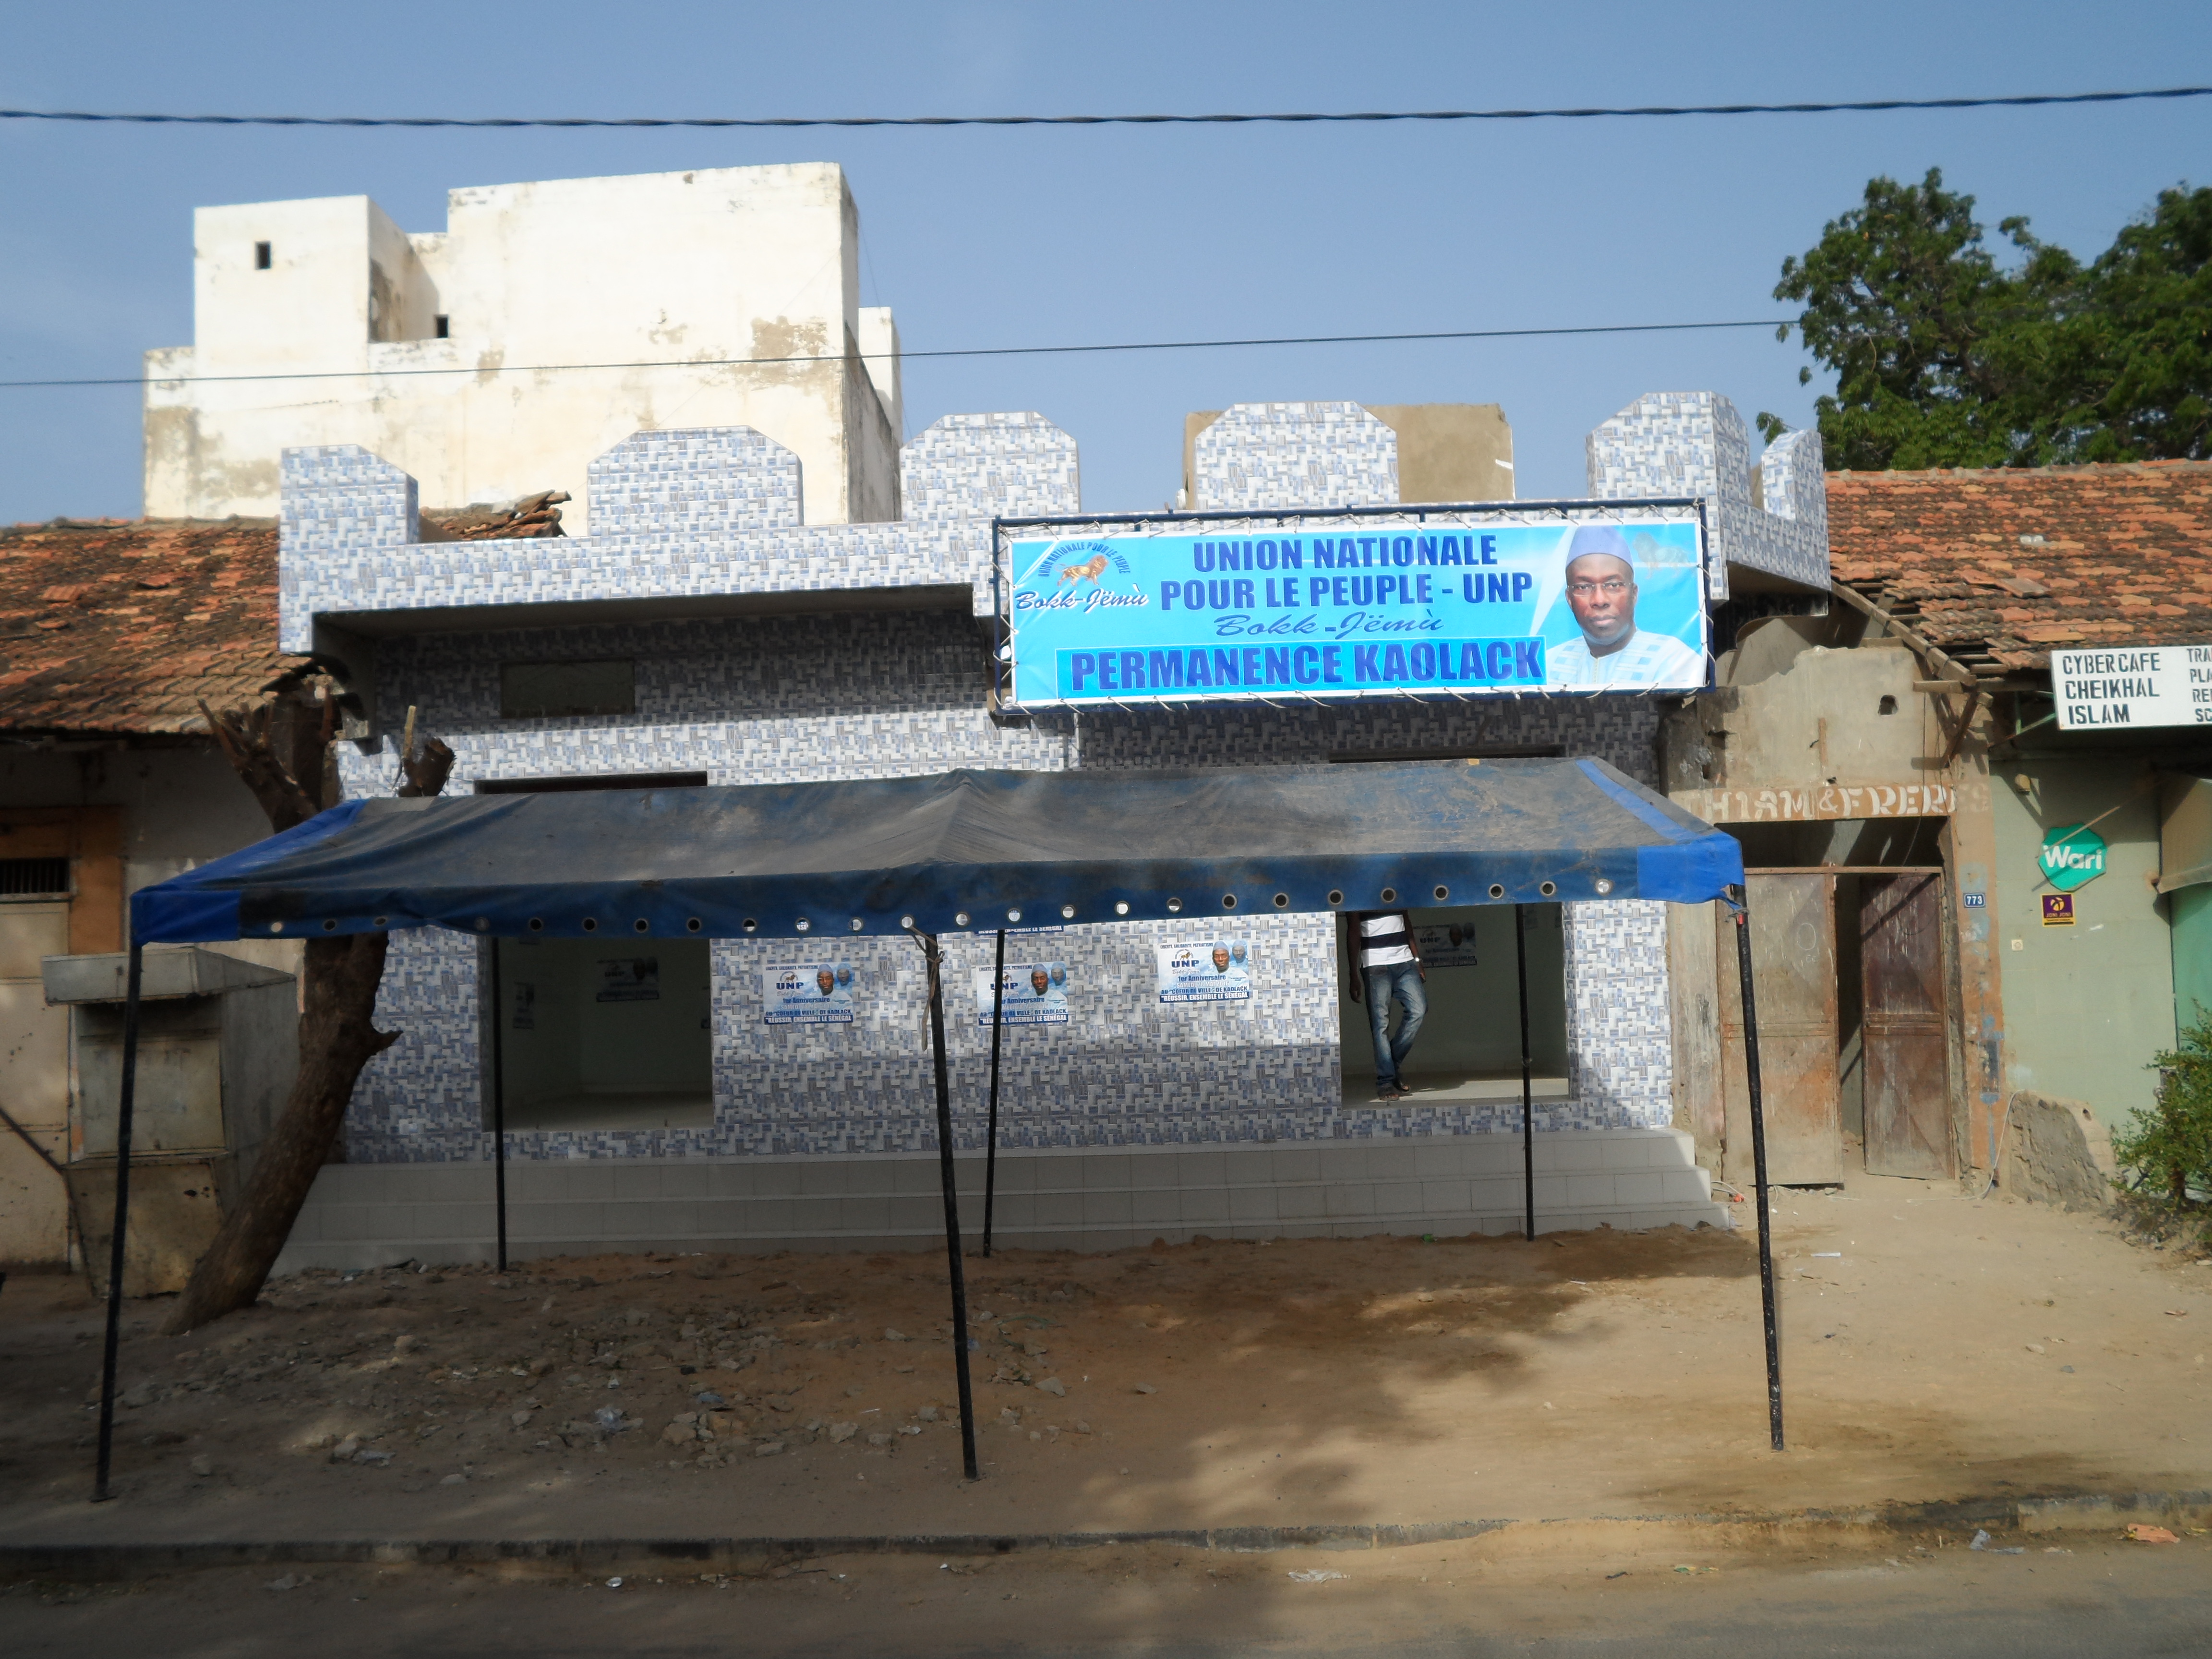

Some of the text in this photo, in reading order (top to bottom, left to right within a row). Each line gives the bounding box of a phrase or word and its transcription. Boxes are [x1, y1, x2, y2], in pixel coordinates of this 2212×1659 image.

[1038, 541, 1131, 577] UNION NATIONALE POUR LE PEUPLE
[1194, 535, 1498, 572] UNION NATIONALE
[1014, 583, 1148, 613] Bokk-Jëmù
[1161, 578, 1255, 611] POUR
[1266, 577, 1300, 608] LE
[1310, 574, 1434, 607] PEUPLE
[1463, 572, 1533, 603] UNP
[1070, 640, 1544, 691] PERMANENCE KAOLACK
[2062, 652, 2161, 674] CYBER CAFE
[2187, 648, 2212, 662] TRA
[2065, 677, 2160, 699] CHEIKHAL
[2192, 688, 2212, 702] RE
[2068, 703, 2131, 725] ISLAM
[2043, 845, 2102, 869] Wari
[1966, 895, 1983, 905] 773
[1171, 960, 1200, 968] UNP
